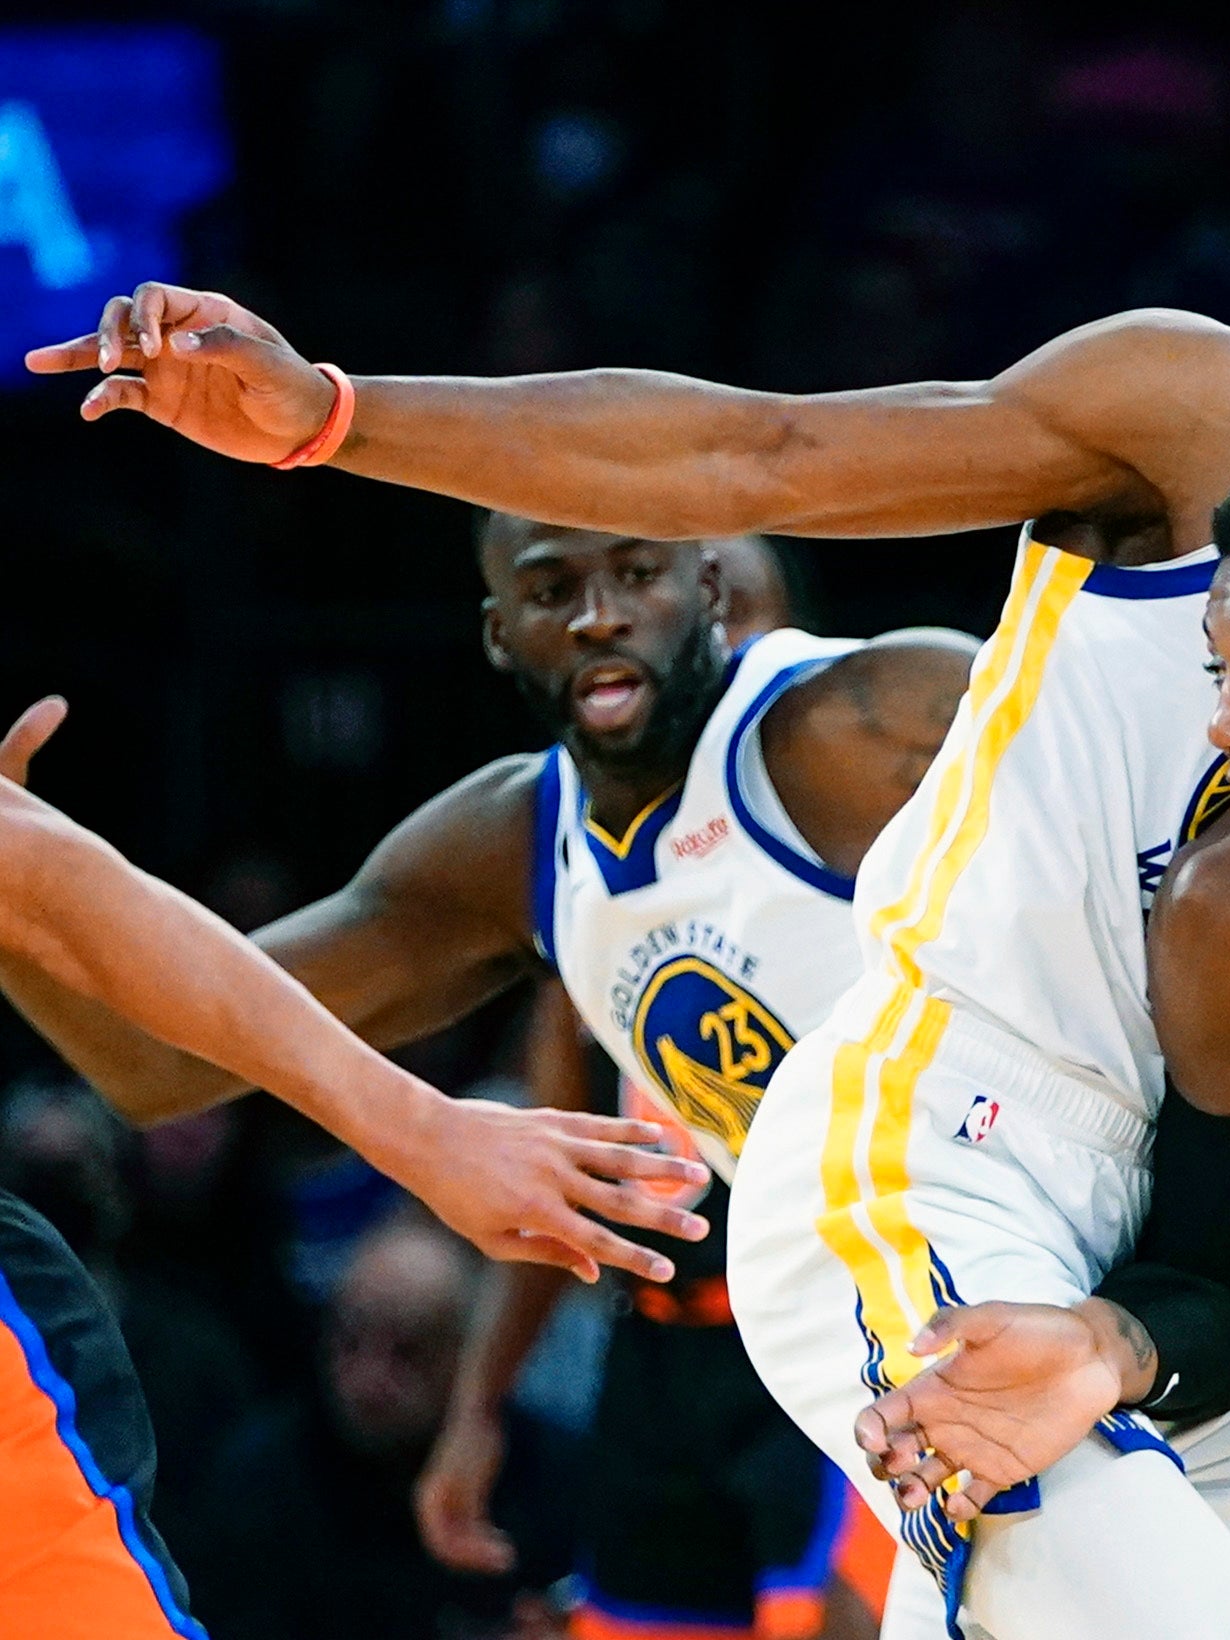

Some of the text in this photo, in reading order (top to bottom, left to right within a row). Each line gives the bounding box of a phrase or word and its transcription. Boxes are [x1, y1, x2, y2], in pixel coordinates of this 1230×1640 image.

[610, 919, 760, 1032] GOLDEN STATE
[701, 998, 771, 1080] 23
